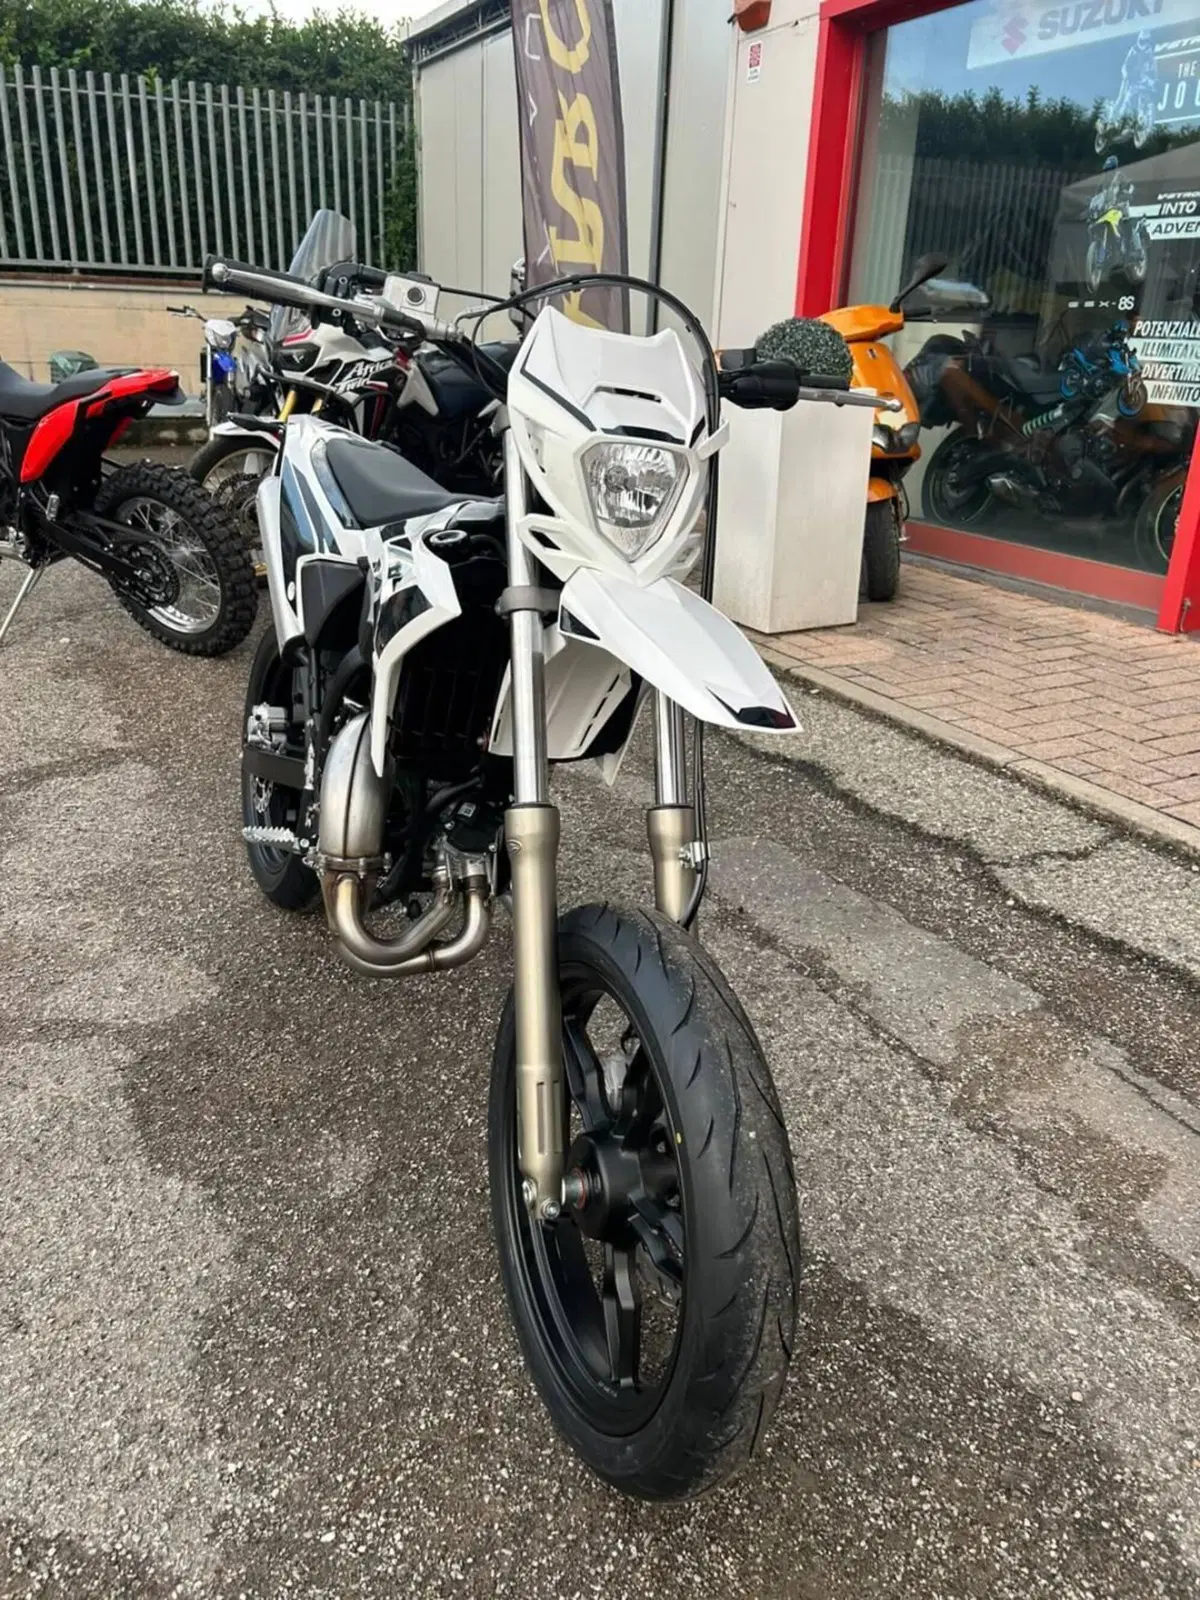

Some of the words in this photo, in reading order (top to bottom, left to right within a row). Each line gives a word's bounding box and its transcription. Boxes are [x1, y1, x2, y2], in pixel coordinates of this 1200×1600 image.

[1178, 60, 1198, 78] THE
[1161, 201, 1197, 216] INTO
[1150, 384, 1200, 402] INFINITO
